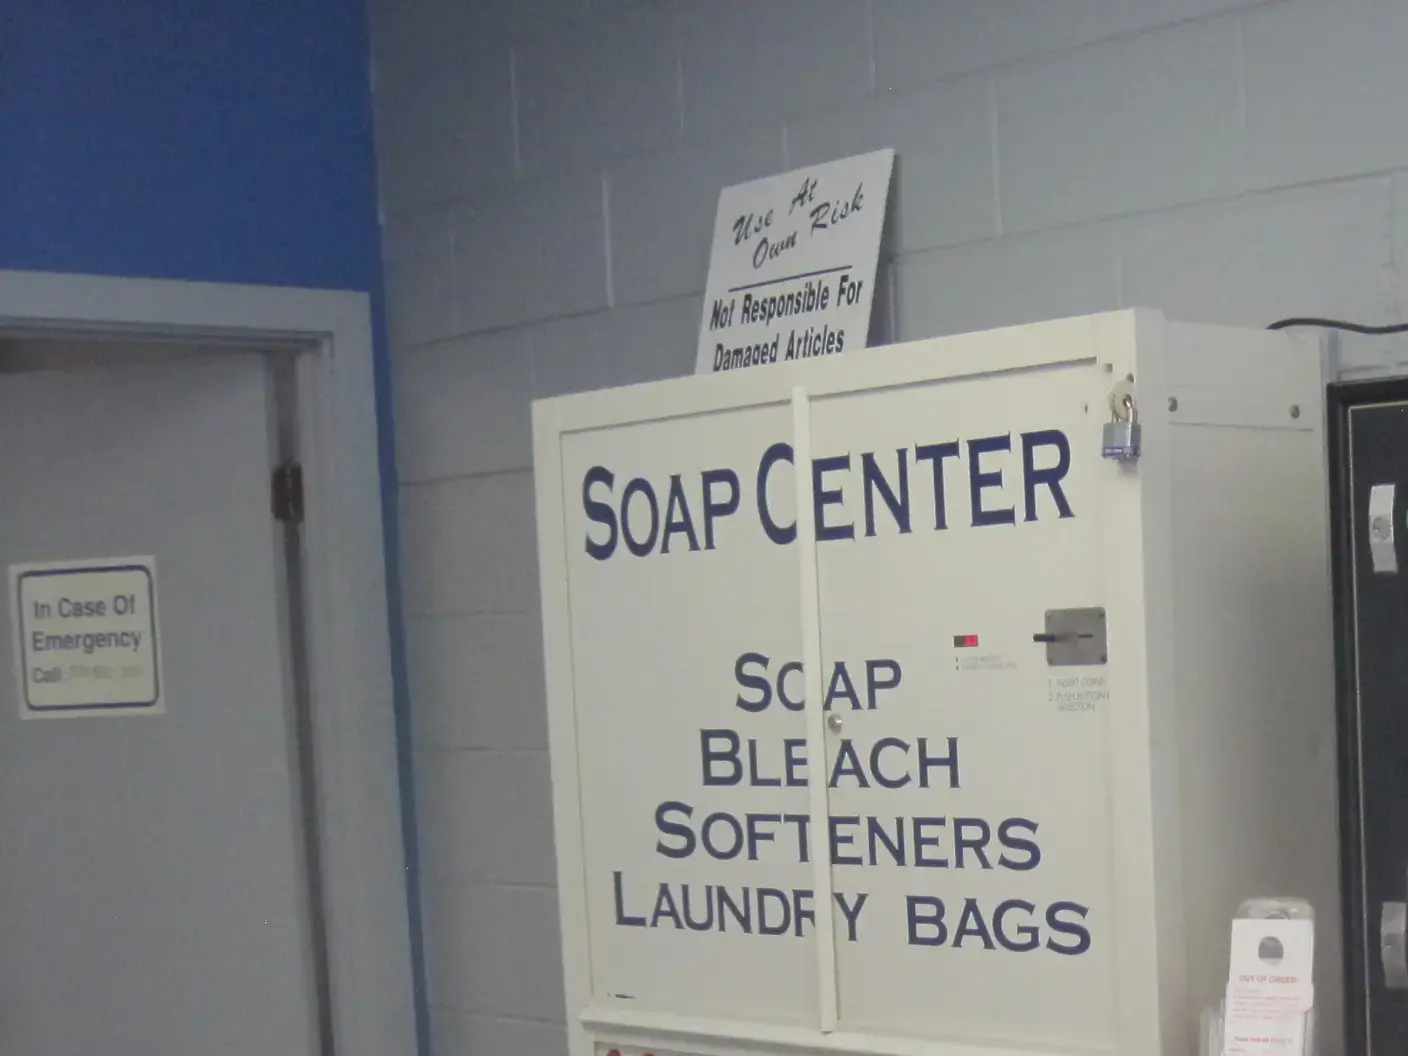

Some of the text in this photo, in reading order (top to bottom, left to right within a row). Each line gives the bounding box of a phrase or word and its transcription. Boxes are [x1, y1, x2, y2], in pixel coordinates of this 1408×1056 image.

[733, 176, 818, 246] Use At
[752, 182, 865, 270] Own Risk
[709, 274, 863, 331] Not Responsible For
[712, 324, 845, 373] Damaged Articles
[582, 429, 1076, 562] SOAP CENTER
[33, 600, 51, 620] In
[57, 597, 107, 618] Case
[32, 630, 141, 655] Emergency
[734, 652, 902, 713] SOAP
[700, 728, 961, 789] BLEACH
[654, 801, 1042, 873] SOFTENERS
[611, 870, 1092, 957] LAUNDRY BAGS
